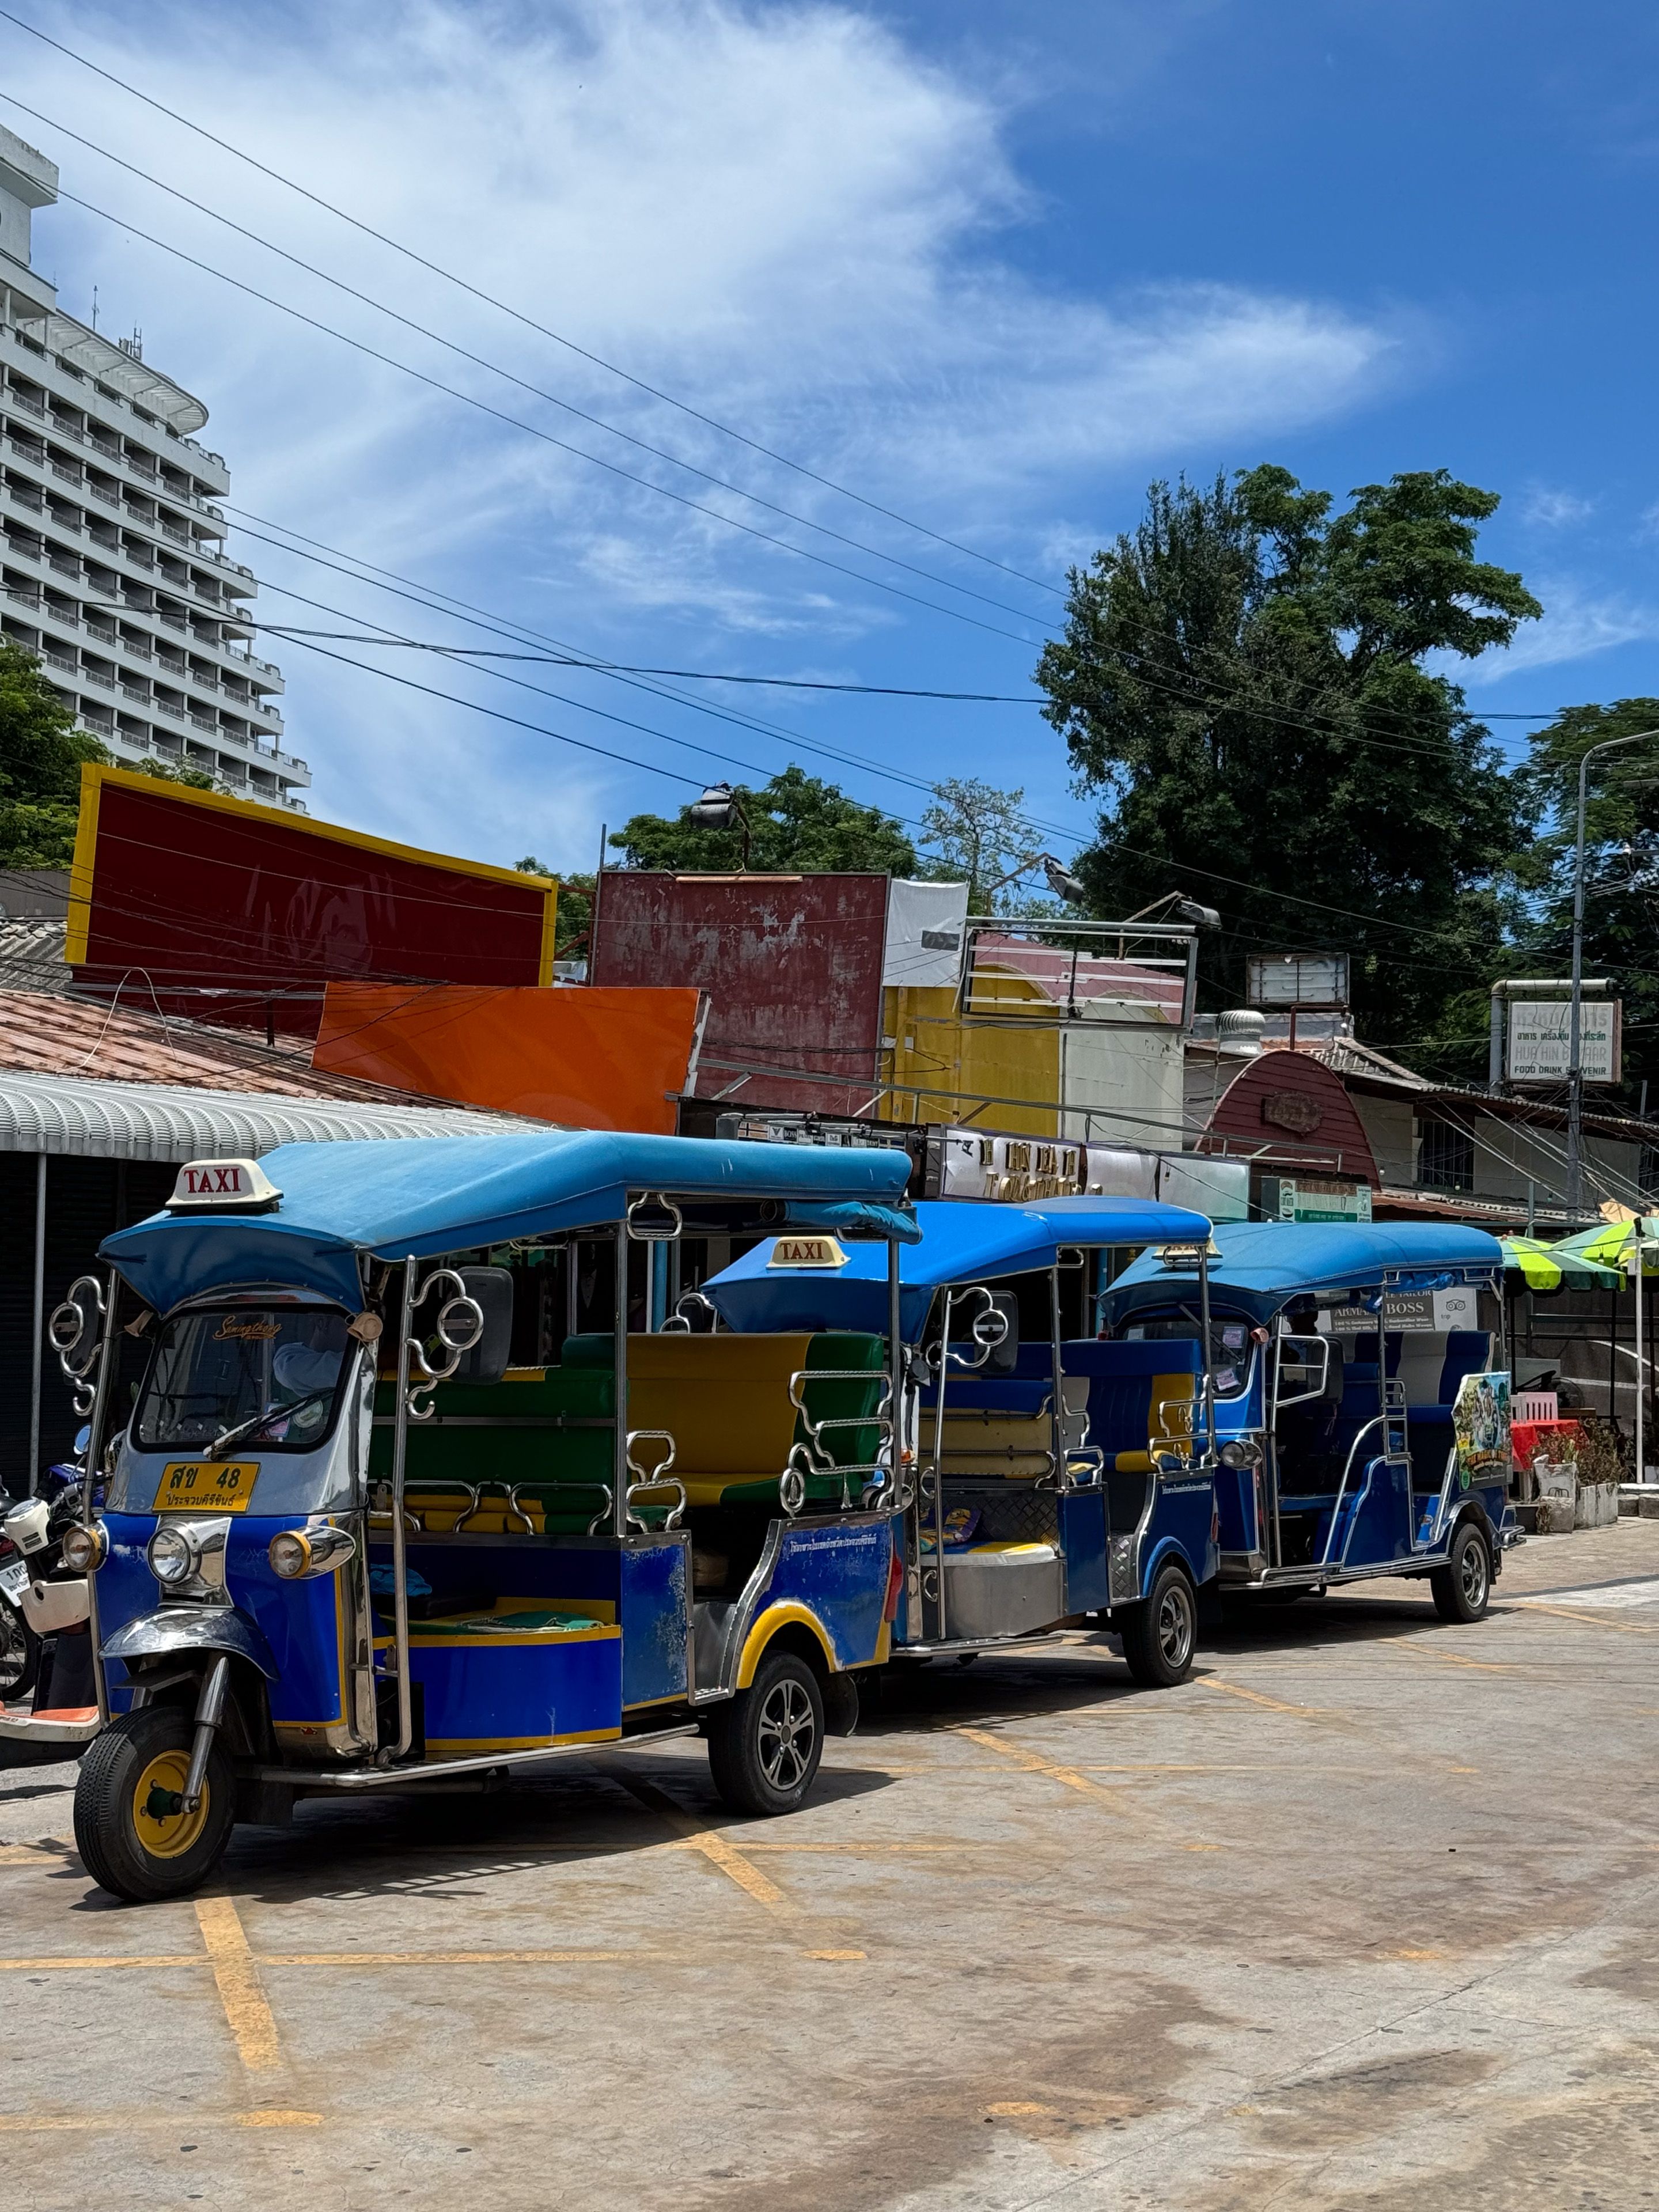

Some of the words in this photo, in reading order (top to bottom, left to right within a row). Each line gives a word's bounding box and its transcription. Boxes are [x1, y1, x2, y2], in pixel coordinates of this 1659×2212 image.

[1539, 1066, 1562, 1074] DRINK
[1566, 1066, 1606, 1075] SVENIR
[183, 1168, 241, 1193] TAXI
[779, 1242, 824, 1260] TAXI
[1386, 1302, 1424, 1314] BOSS
[215, 1467, 241, 1489] 48
[167, 1493, 236, 1506] ประจวบคีรีขันธ์
